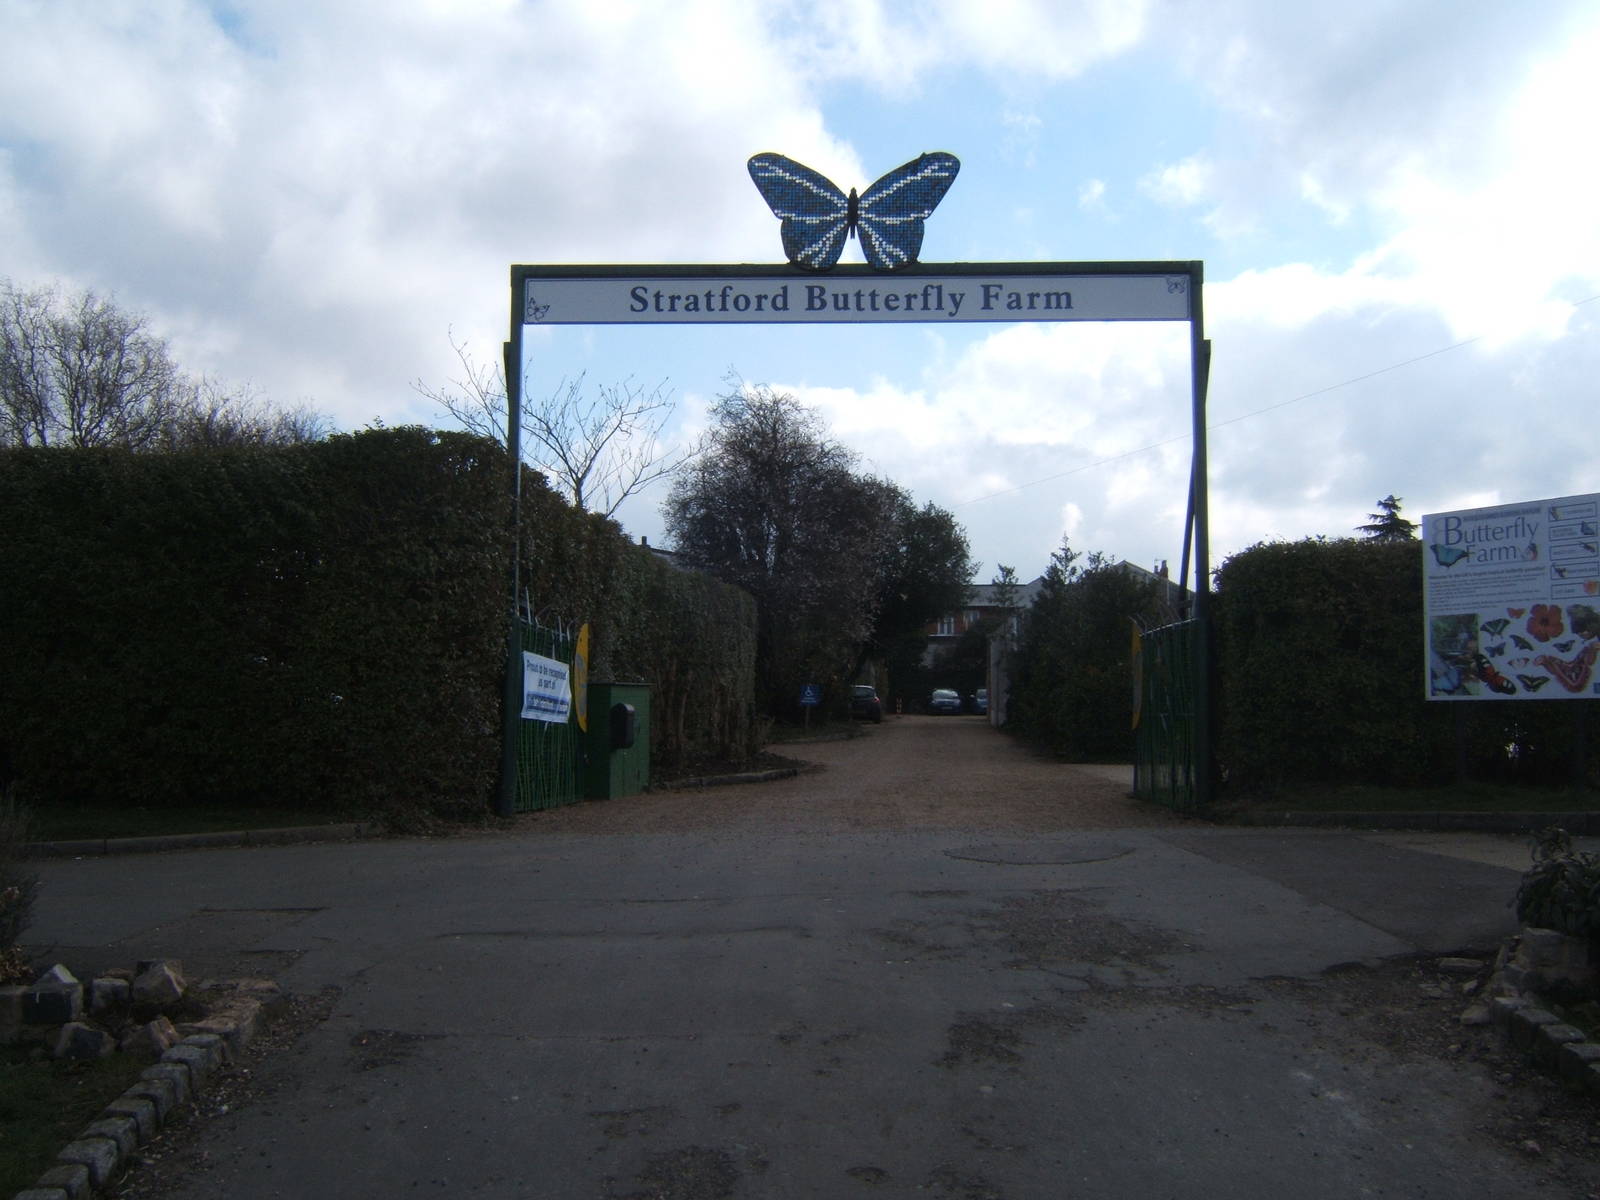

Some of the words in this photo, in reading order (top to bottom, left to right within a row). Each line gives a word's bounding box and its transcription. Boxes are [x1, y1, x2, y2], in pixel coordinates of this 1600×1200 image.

[630, 285, 789, 312] Stratford
[805, 284, 965, 317] Butterfly
[980, 284, 1074, 311] Farm
[1444, 516, 1538, 545] Butterfly
[1466, 544, 1517, 563] Farm
